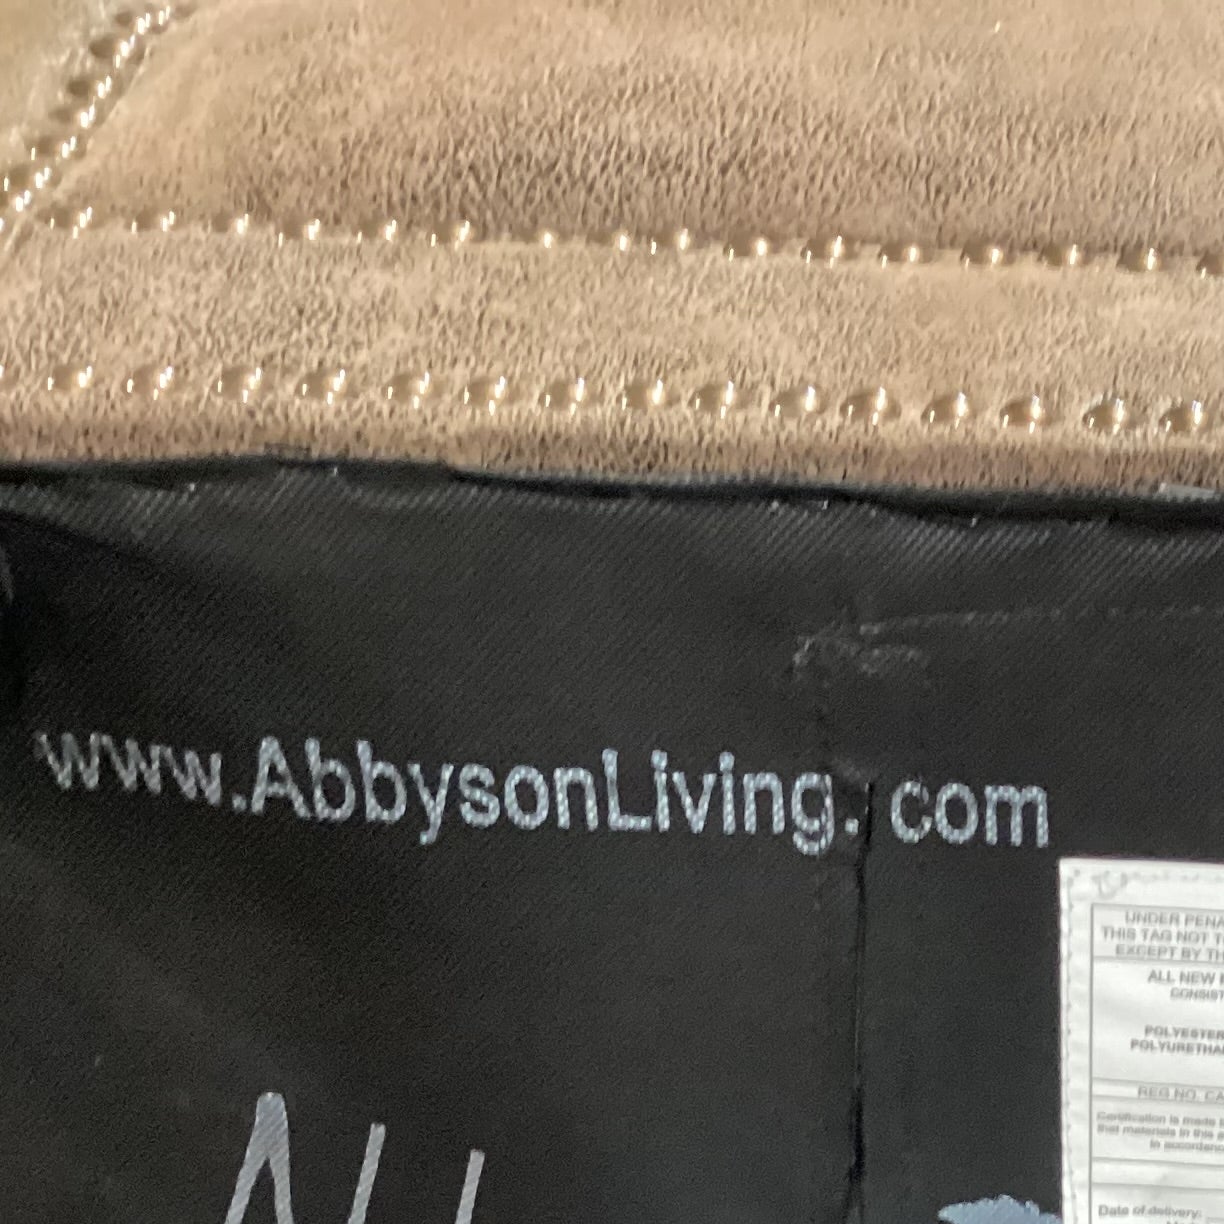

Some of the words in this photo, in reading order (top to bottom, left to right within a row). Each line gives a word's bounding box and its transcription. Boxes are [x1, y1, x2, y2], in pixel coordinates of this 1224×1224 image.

[890, 780, 1049, 848] com
[1125, 911, 1180, 926] UNDER
[1102, 926, 1136, 941] THIS
[1141, 928, 1172, 942] TAG
[1176, 930, 1207, 944] NOT
[1115, 944, 1176, 959] EXCEPT
[1181, 946, 1202, 960] BY
[1147, 969, 1175, 984] ALL
[1179, 971, 1216, 985] NEW
[1098, 1204, 1129, 1217] Date
[1132, 1204, 1146, 1216] of
